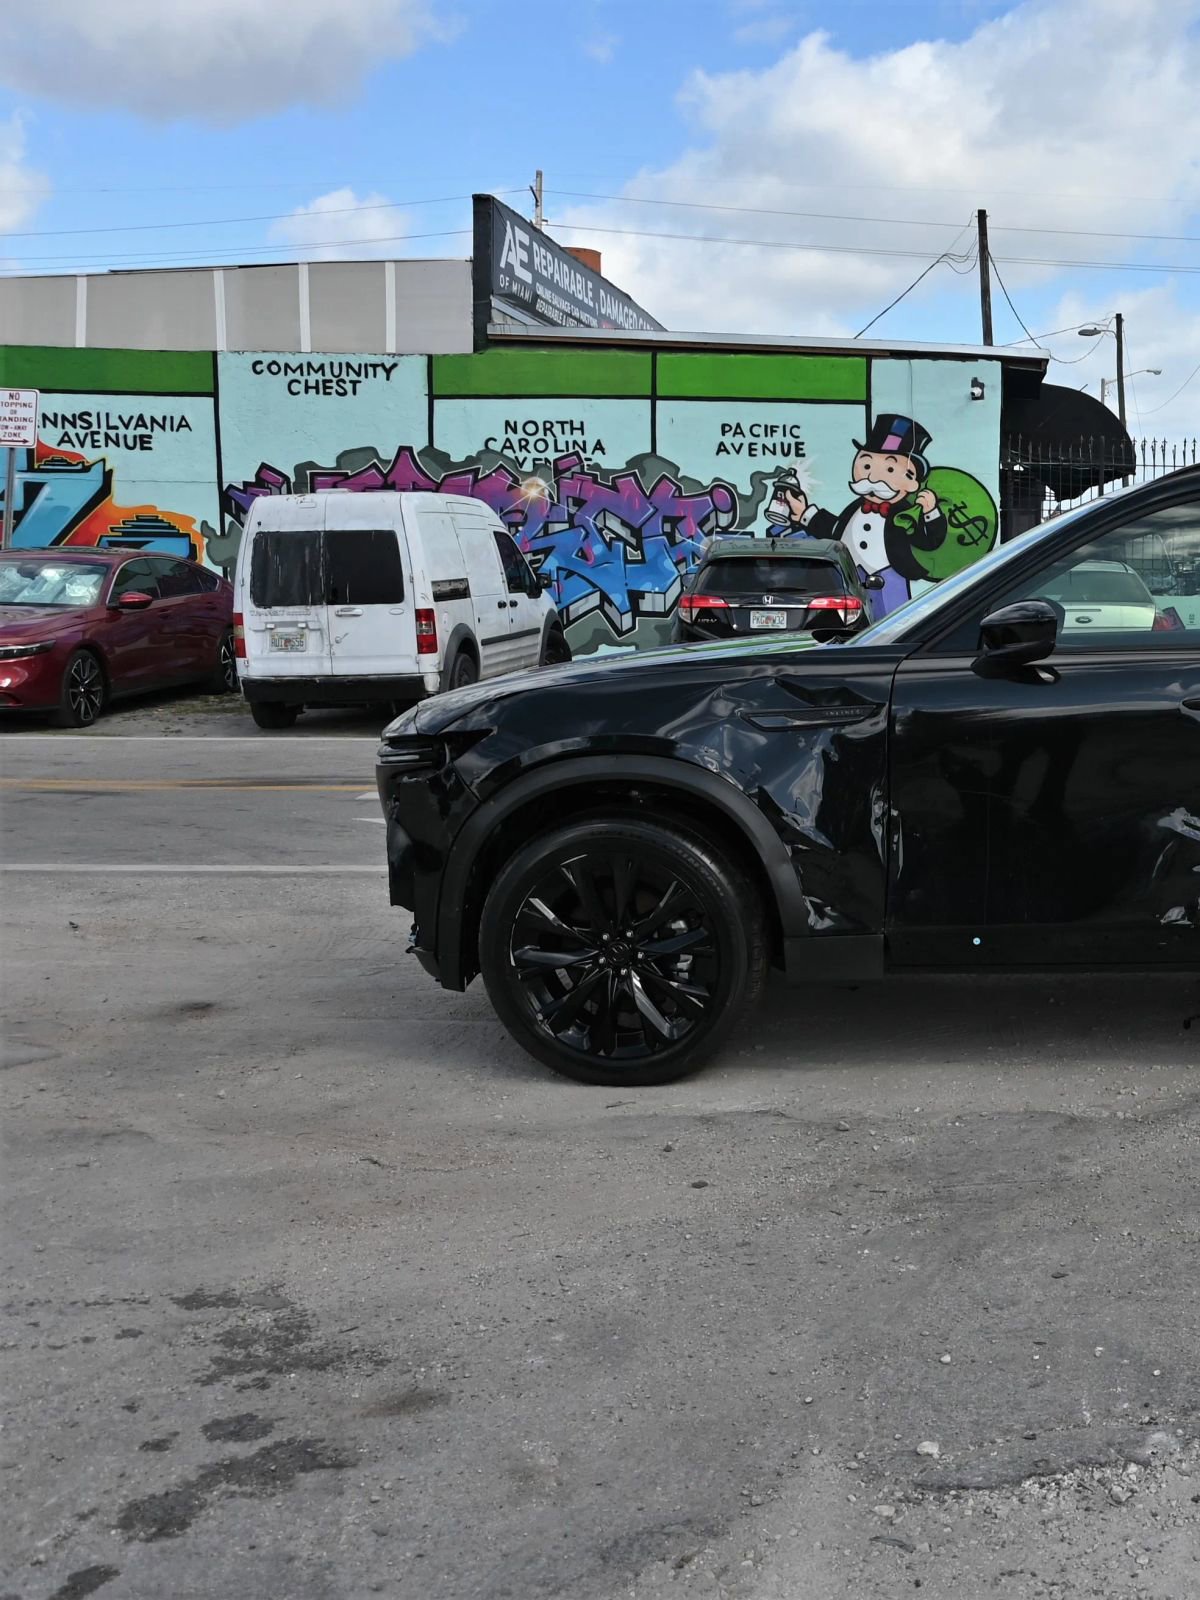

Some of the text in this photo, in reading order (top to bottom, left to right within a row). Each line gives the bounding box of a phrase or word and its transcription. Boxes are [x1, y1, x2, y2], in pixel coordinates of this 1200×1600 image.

[500, 220, 532, 284] AE
[500, 274, 534, 303] OF MIAMI
[252, 360, 399, 381] COMMUNITY
[9, 392, 20, 401] NO
[287, 379, 362, 397] CHEST
[37, 411, 193, 433] NNSILVANIA
[504, 419, 585, 438] NORTH
[720, 422, 801, 439] PACIFIC
[57, 431, 153, 451] AVENUE
[484, 437, 606, 455] CAROLINA
[716, 441, 806, 458] AVENUE
